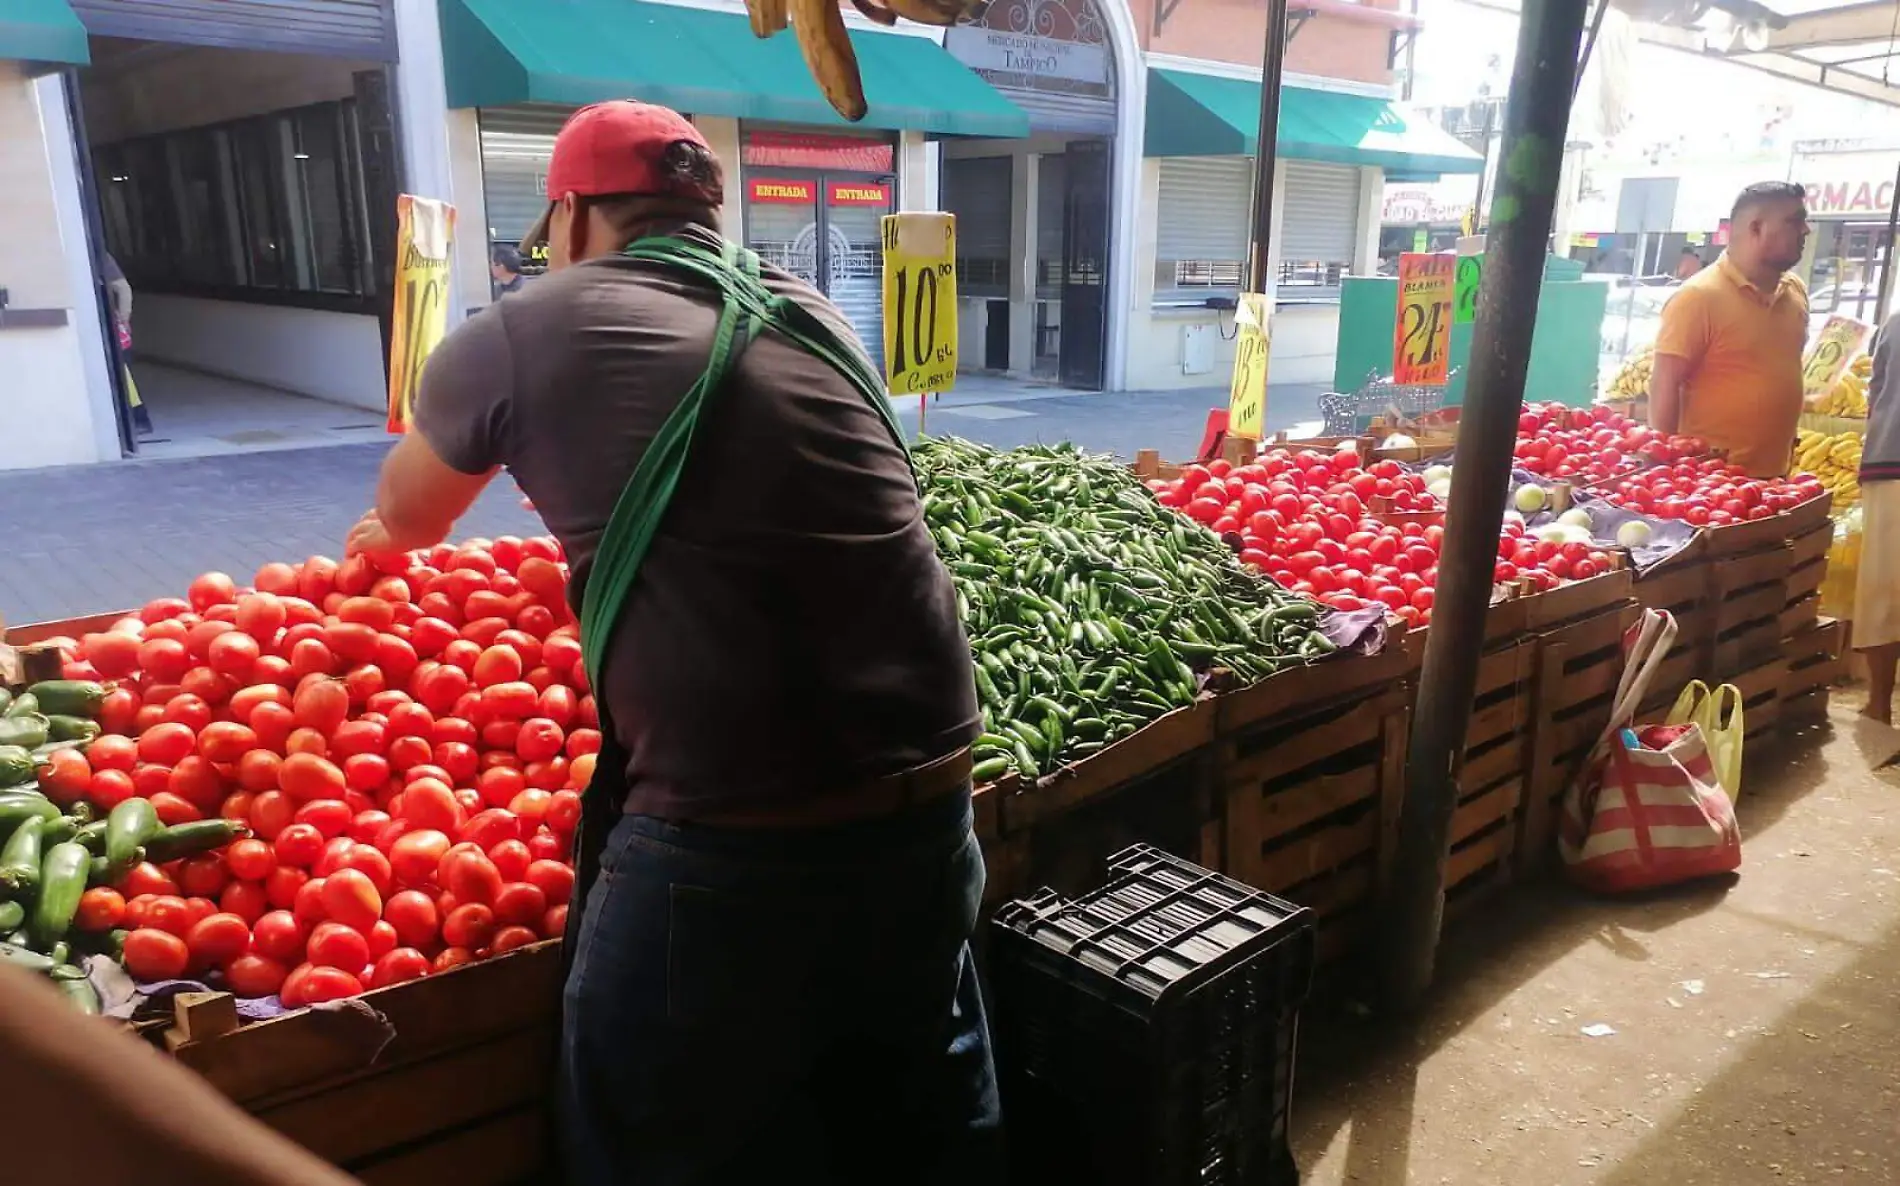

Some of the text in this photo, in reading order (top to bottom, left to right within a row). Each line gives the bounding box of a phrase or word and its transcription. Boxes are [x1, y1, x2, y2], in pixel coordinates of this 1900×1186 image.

[756, 185, 808, 198] ENTRADA
[836, 188, 883, 201] ENTRADA
[893, 266, 937, 379] 10
